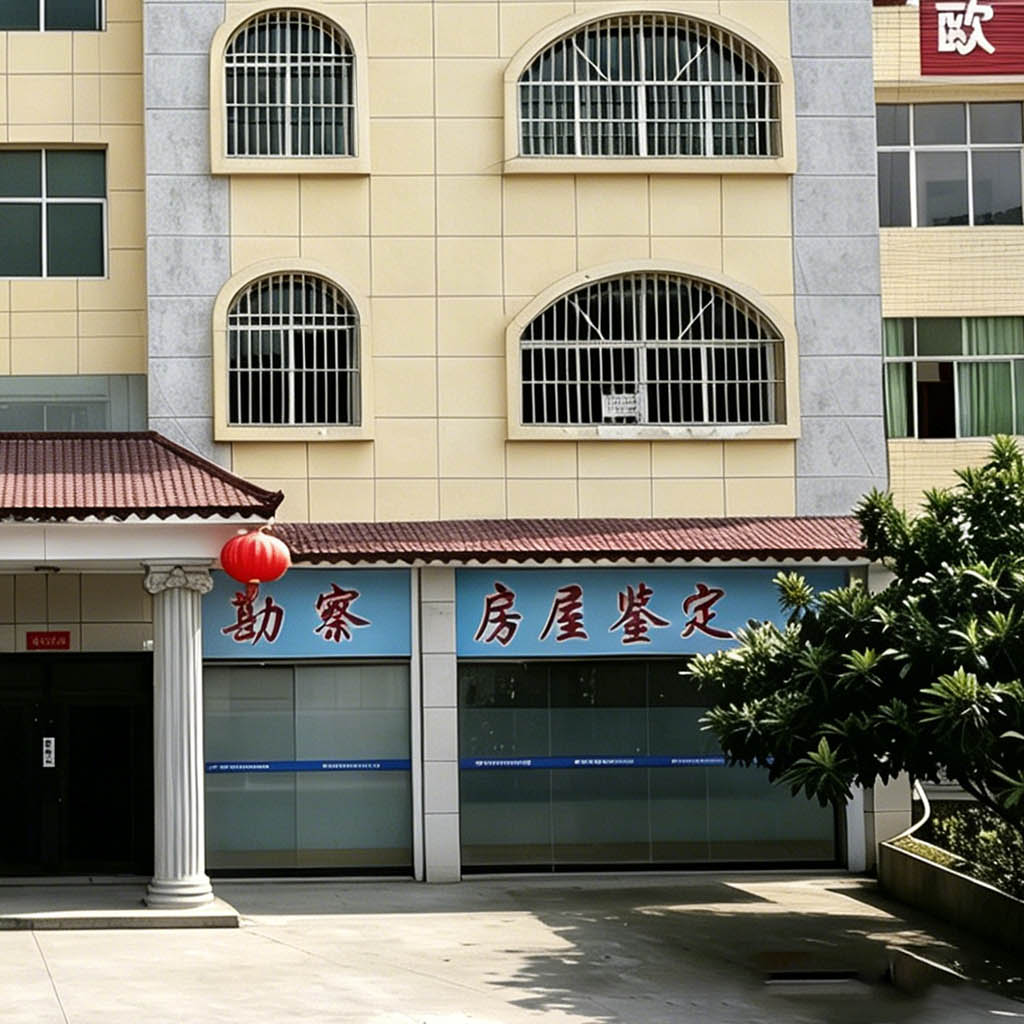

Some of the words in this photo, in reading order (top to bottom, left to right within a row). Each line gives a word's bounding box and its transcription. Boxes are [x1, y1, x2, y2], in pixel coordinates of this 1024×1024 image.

[221, 582, 373, 646] 勘察
[473, 580, 737, 647] 房屋鉴定
